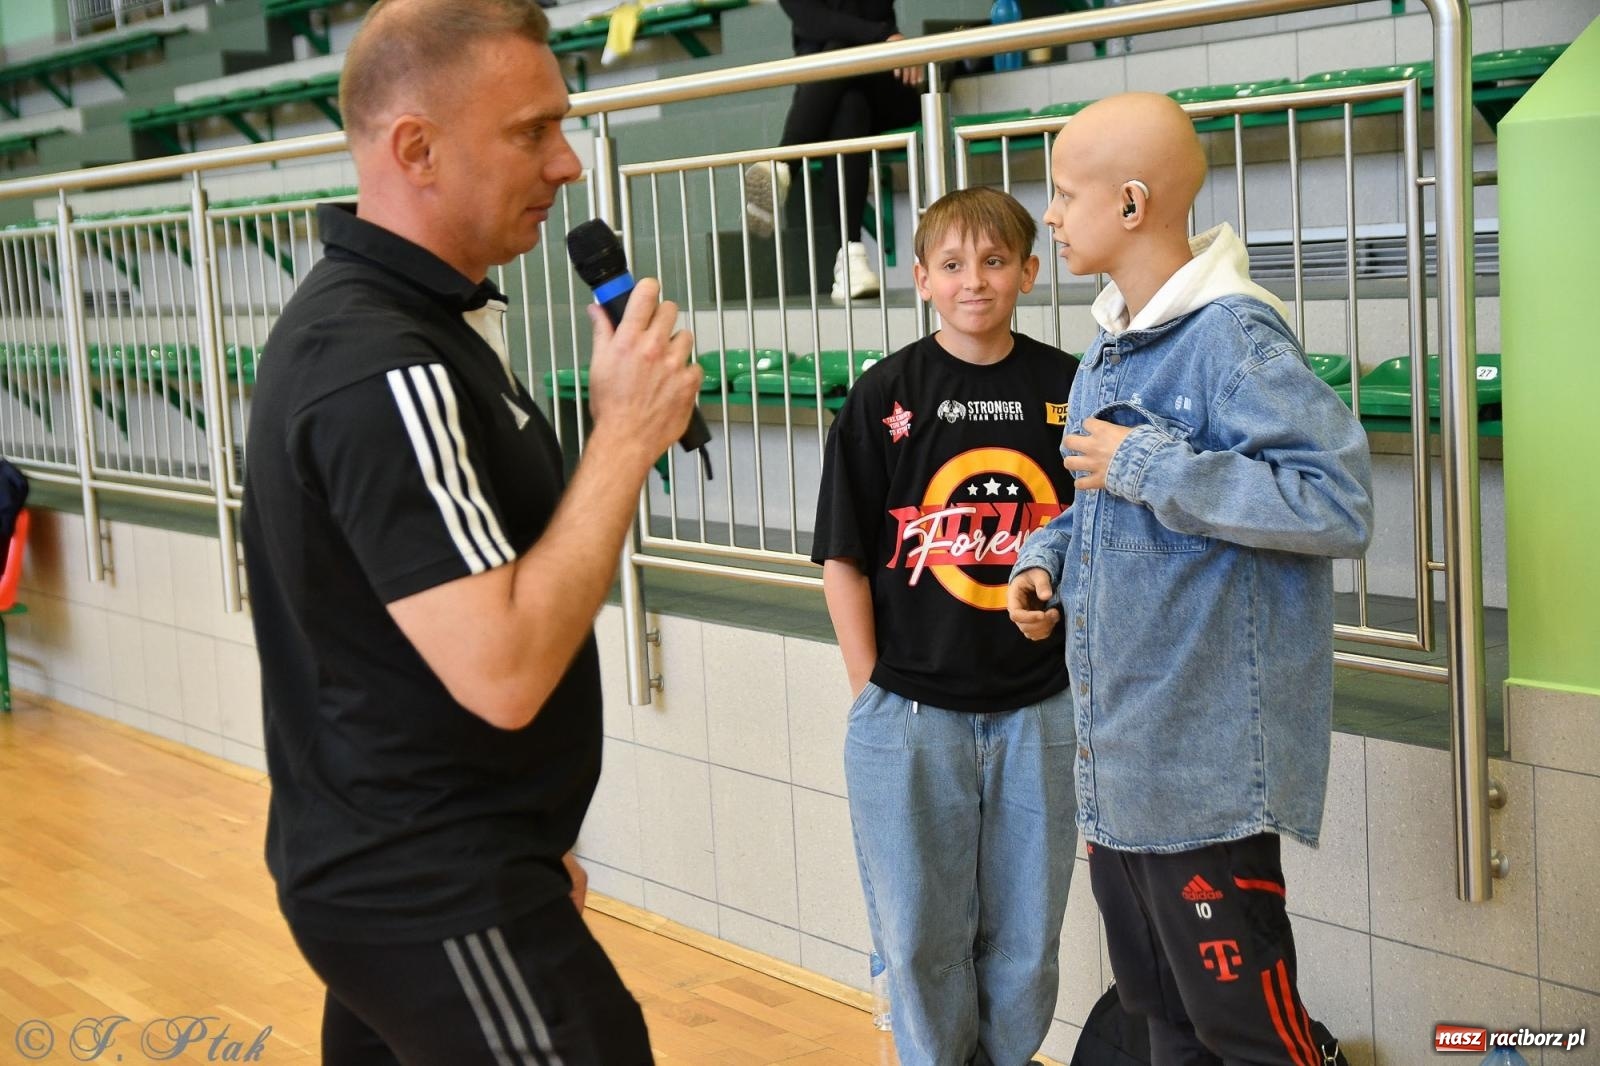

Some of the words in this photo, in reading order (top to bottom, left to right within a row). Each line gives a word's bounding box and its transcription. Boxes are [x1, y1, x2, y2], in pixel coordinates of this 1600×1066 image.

[1478, 368, 1493, 378] 27
[967, 400, 1023, 415] STRONGER
[968, 413, 989, 421] THAN
[993, 413, 1024, 421] BEFORE
[903, 506, 1044, 587] Forev
[1181, 890, 1224, 901] adidas
[1195, 902, 1212, 919] 10
